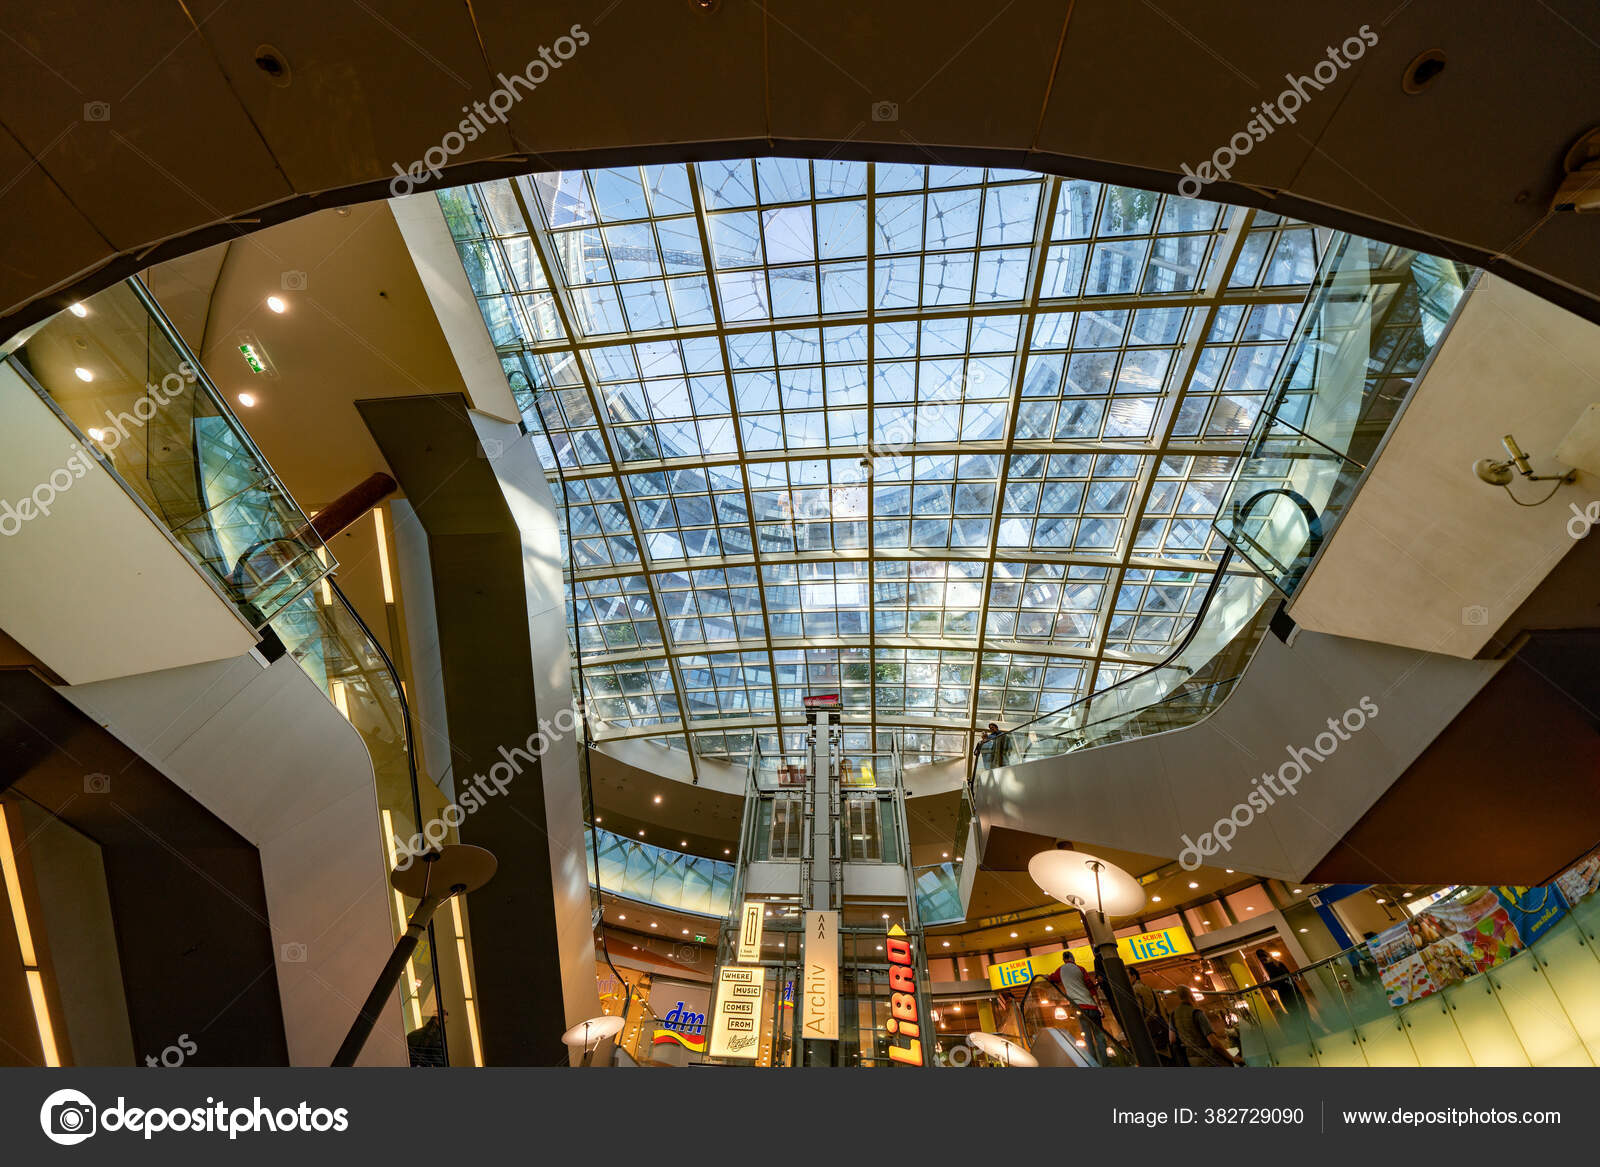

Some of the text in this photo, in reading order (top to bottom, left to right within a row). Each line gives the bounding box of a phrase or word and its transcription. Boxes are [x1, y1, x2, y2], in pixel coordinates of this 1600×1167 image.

[724, 972, 750, 981] WHERE
[735, 986, 759, 995] MUSIC
[806, 964, 826, 1035] Archiv
[725, 1003, 751, 1012] COMES
[663, 1001, 705, 1034] dm
[730, 1020, 751, 1029] FROM
